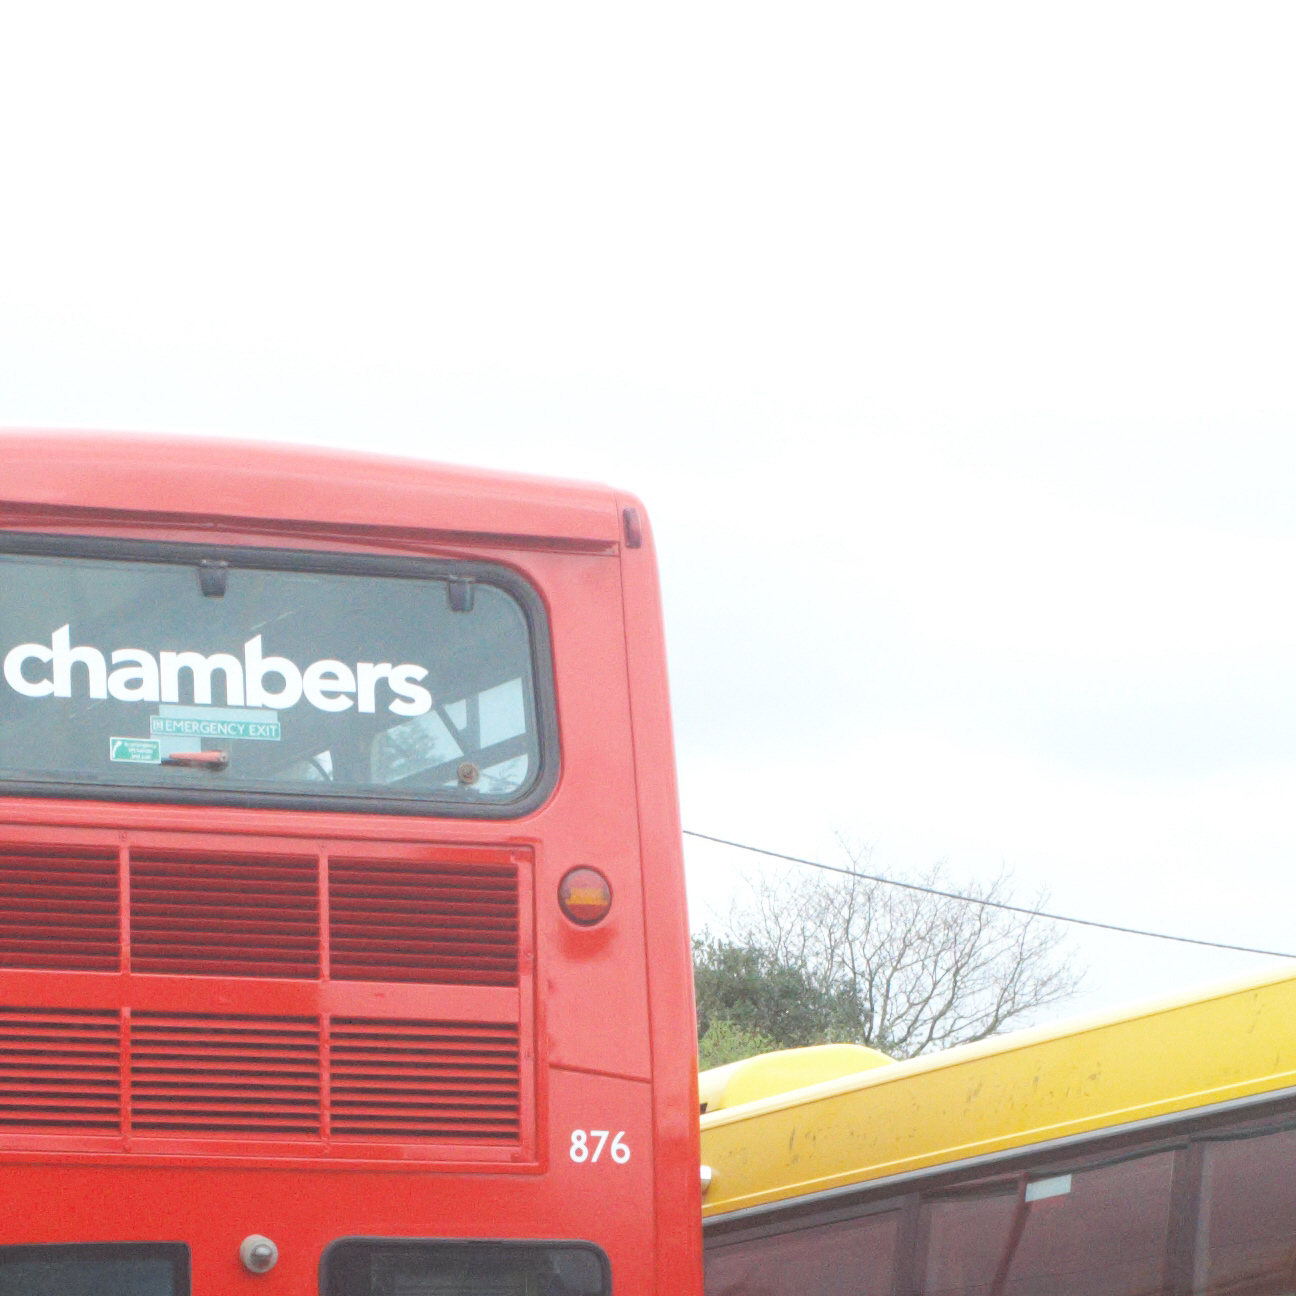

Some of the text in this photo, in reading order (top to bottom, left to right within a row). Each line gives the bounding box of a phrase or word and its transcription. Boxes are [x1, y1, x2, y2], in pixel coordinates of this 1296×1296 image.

[4, 624, 432, 716] chambers
[166, 720, 244, 735] EMERGENCY
[249, 725, 278, 737] EXIT
[569, 1130, 630, 1165] 876
